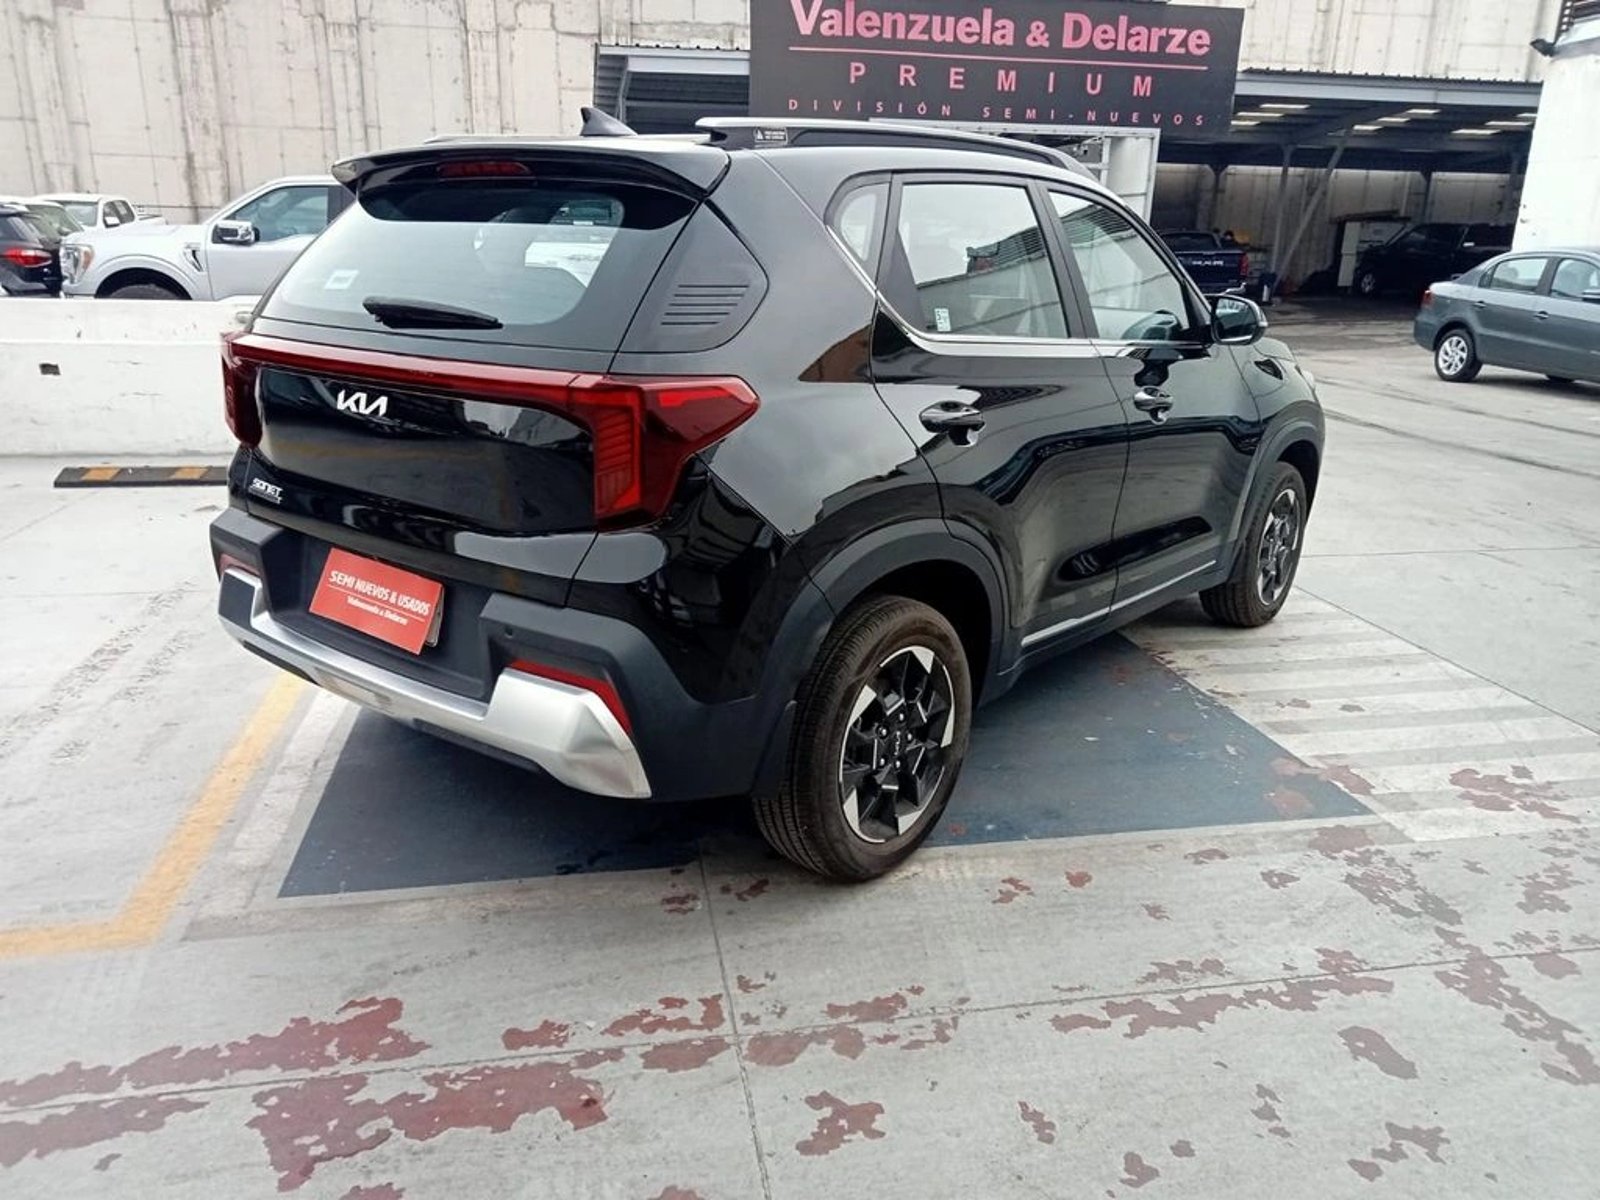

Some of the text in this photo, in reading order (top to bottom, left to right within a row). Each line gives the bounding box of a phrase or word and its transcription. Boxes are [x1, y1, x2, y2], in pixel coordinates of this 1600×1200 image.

[790, 0, 1211, 56] Valenzuela & Delarze
[850, 62, 1152, 97] PREMIUM
[788, 99, 951, 117] DIVISIÓN
[336, 389, 389, 417] KIA
[329, 570, 354, 589] SEMI
[354, 578, 391, 601] NUEVOS
[398, 594, 431, 616] USADOS
